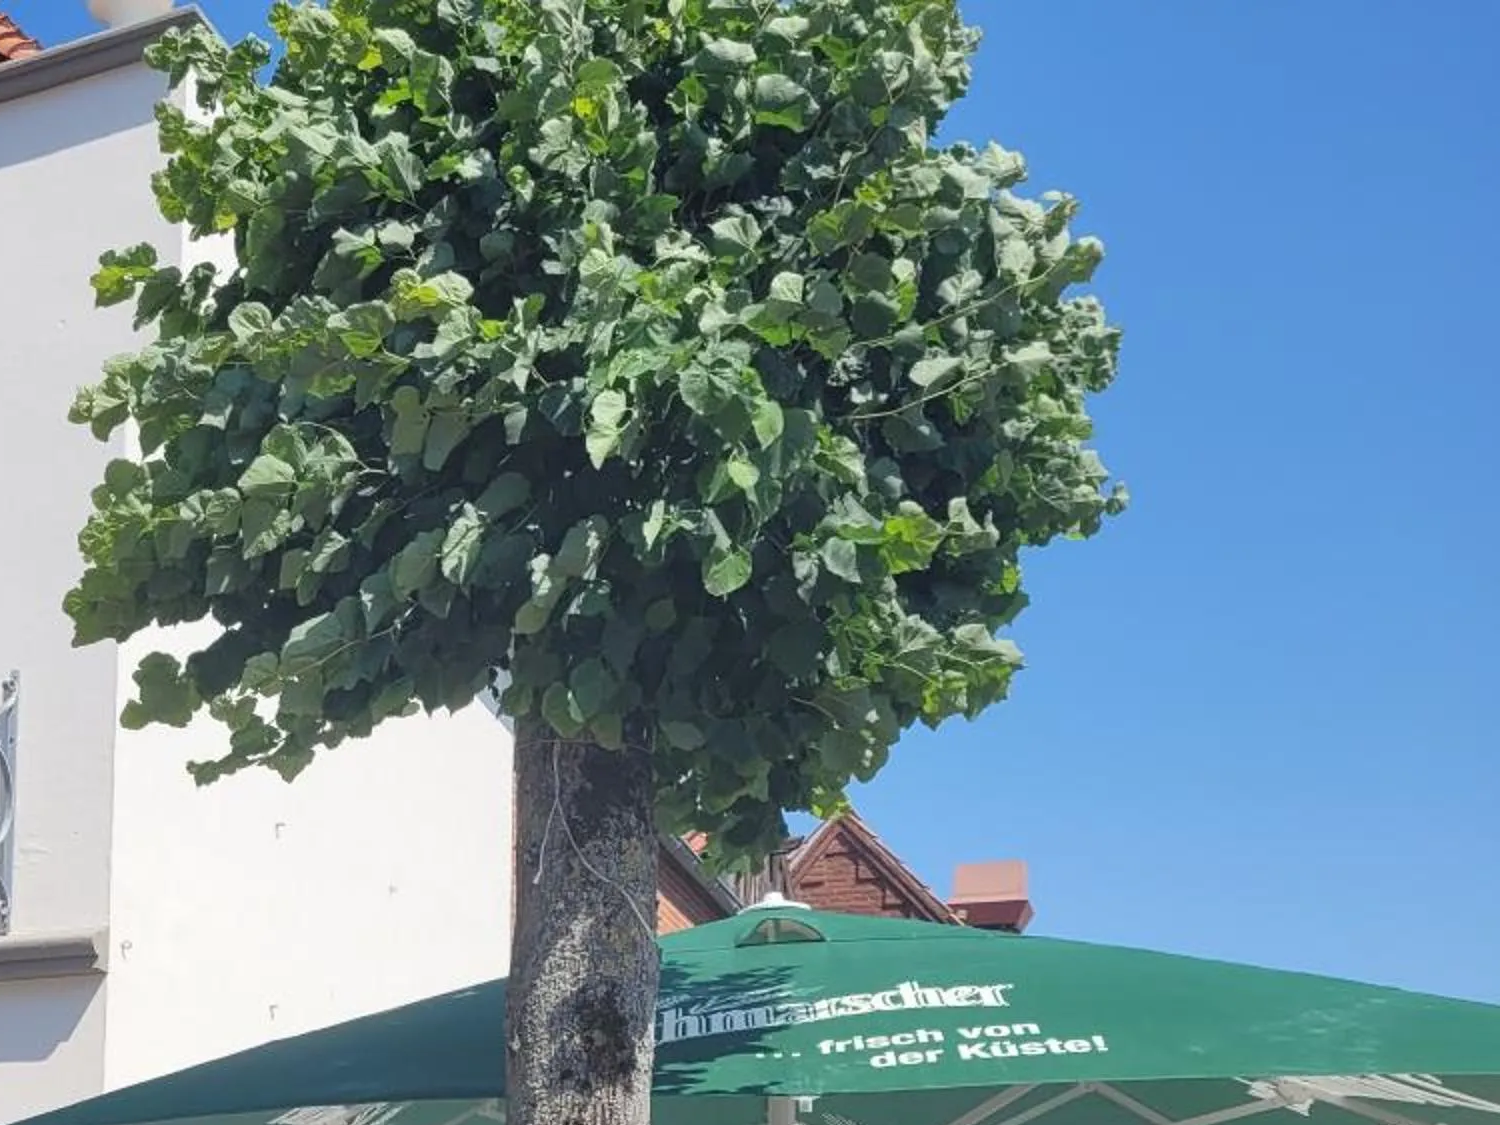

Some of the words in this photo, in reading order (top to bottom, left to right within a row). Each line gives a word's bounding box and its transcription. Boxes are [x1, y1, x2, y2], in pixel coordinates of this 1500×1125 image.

[656, 980, 1014, 1043] hmarscher
[817, 1026, 945, 1056] frisch
[956, 1020, 1041, 1040] von
[869, 1047, 944, 1069] der
[957, 1033, 1109, 1062] Küste!
